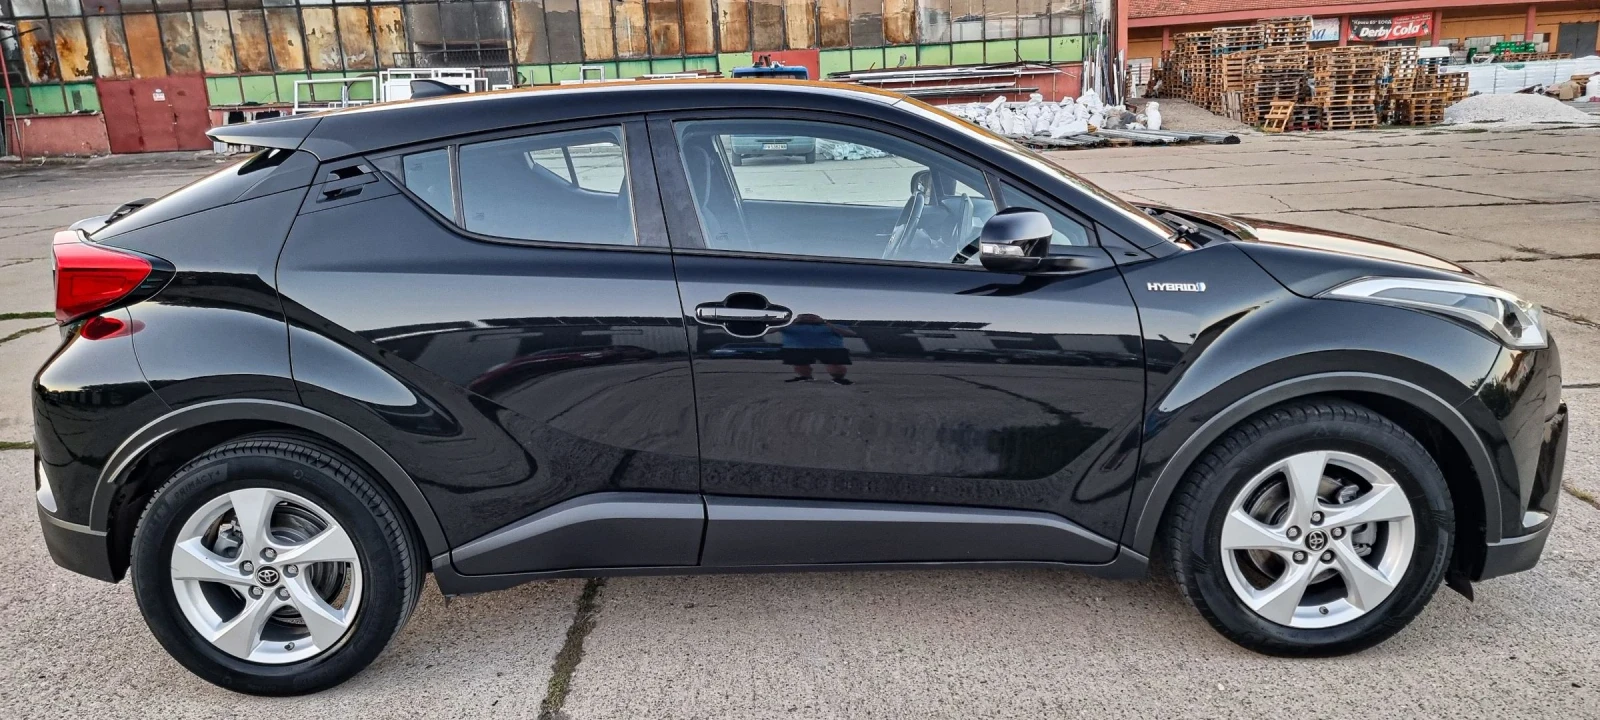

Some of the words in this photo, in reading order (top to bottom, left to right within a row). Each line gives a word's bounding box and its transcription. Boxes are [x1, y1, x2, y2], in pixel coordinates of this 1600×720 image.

[1360, 26, 1392, 39] Derby
[1393, 22, 1421, 36] Cola
[1147, 282, 1197, 291] HYBRID
